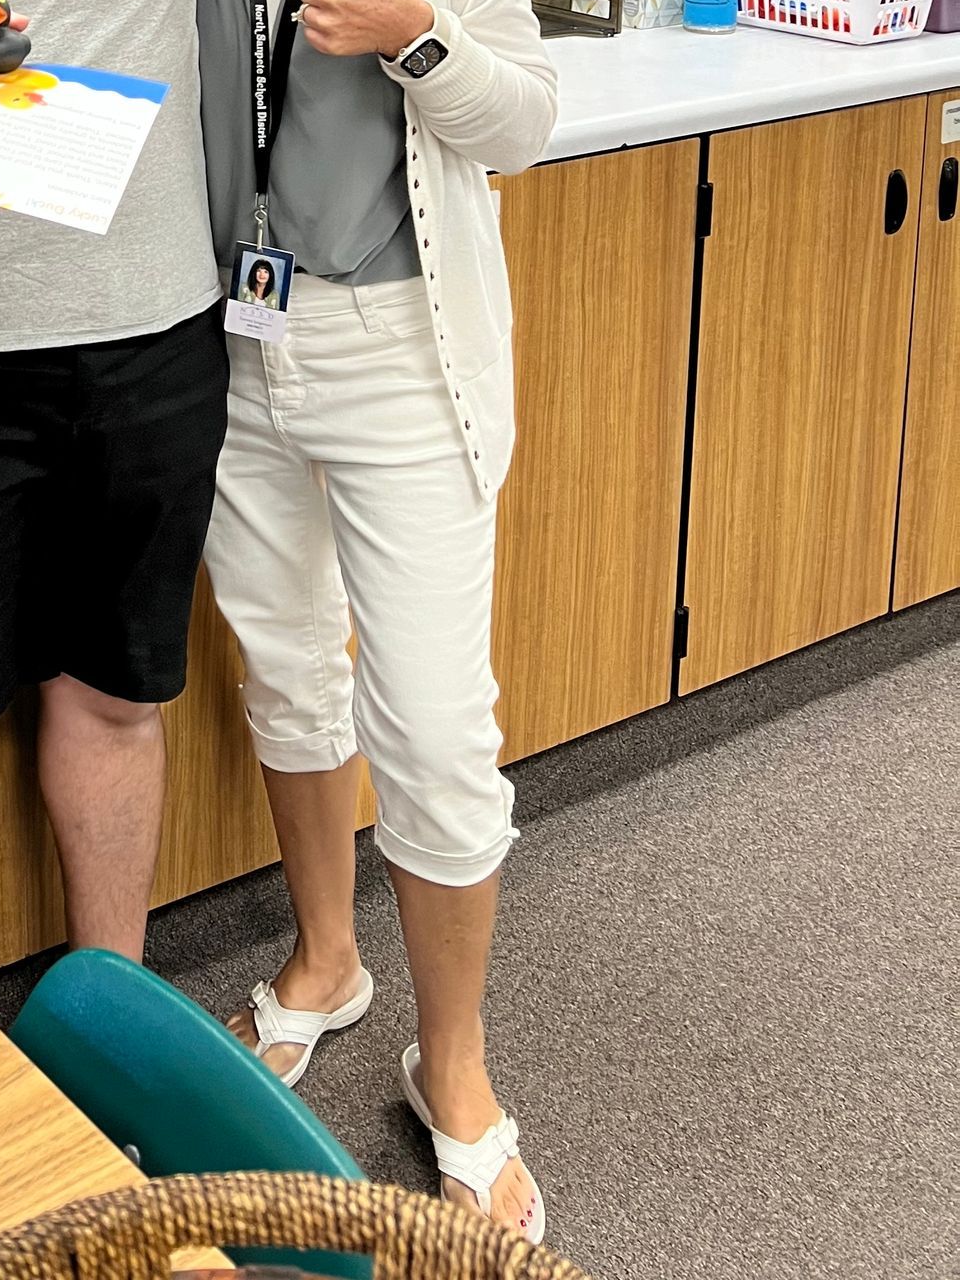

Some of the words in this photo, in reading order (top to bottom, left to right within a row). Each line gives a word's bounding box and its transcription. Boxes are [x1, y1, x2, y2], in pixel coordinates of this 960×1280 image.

[254, 4, 266, 35] North
[254, 34, 266, 74] Sanpete
[255, 76, 267, 109] School
[257, 112, 267, 148] District
[67, 207, 108, 226] Lucky
